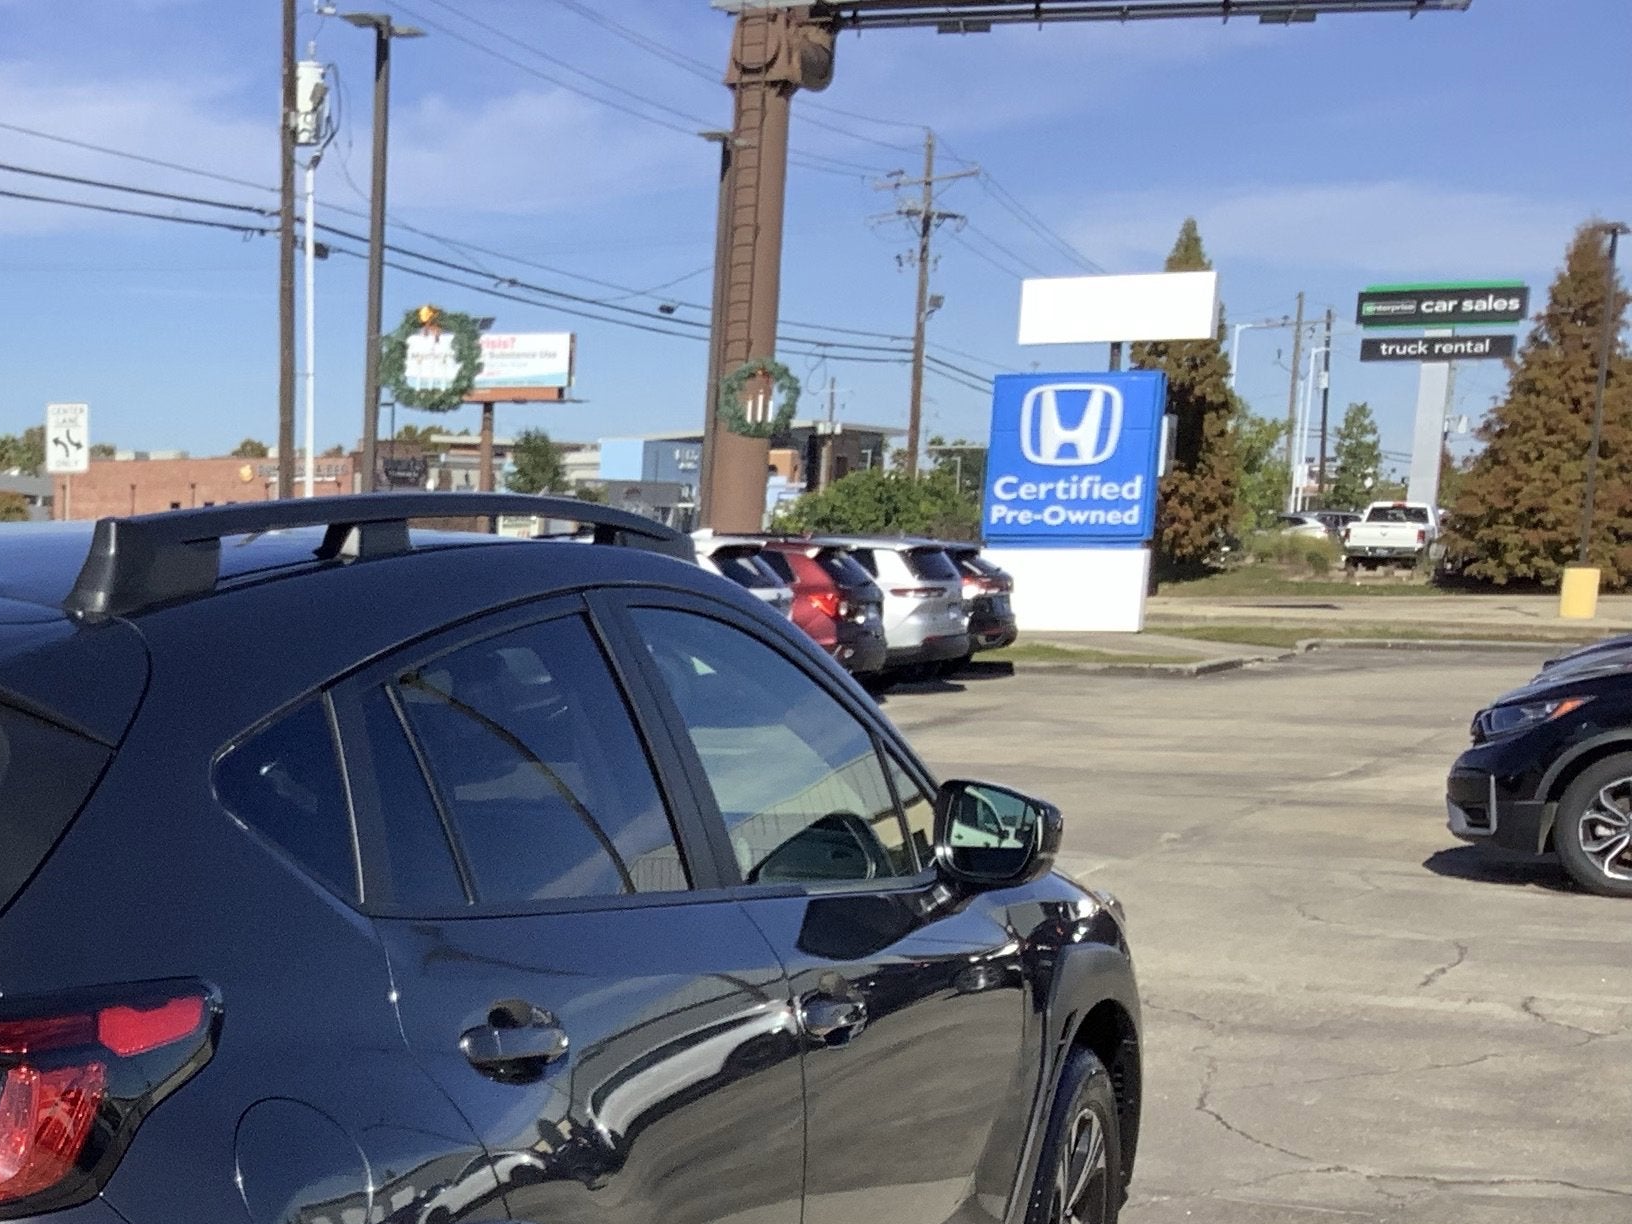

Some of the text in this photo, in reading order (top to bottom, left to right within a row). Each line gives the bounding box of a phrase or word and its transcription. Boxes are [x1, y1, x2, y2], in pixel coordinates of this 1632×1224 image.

[1364, 294, 1520, 314] enterprise car sales
[1380, 339, 1490, 356] truck rental
[993, 475, 1143, 500] Certified
[990, 504, 1140, 526] Pre-Owned
